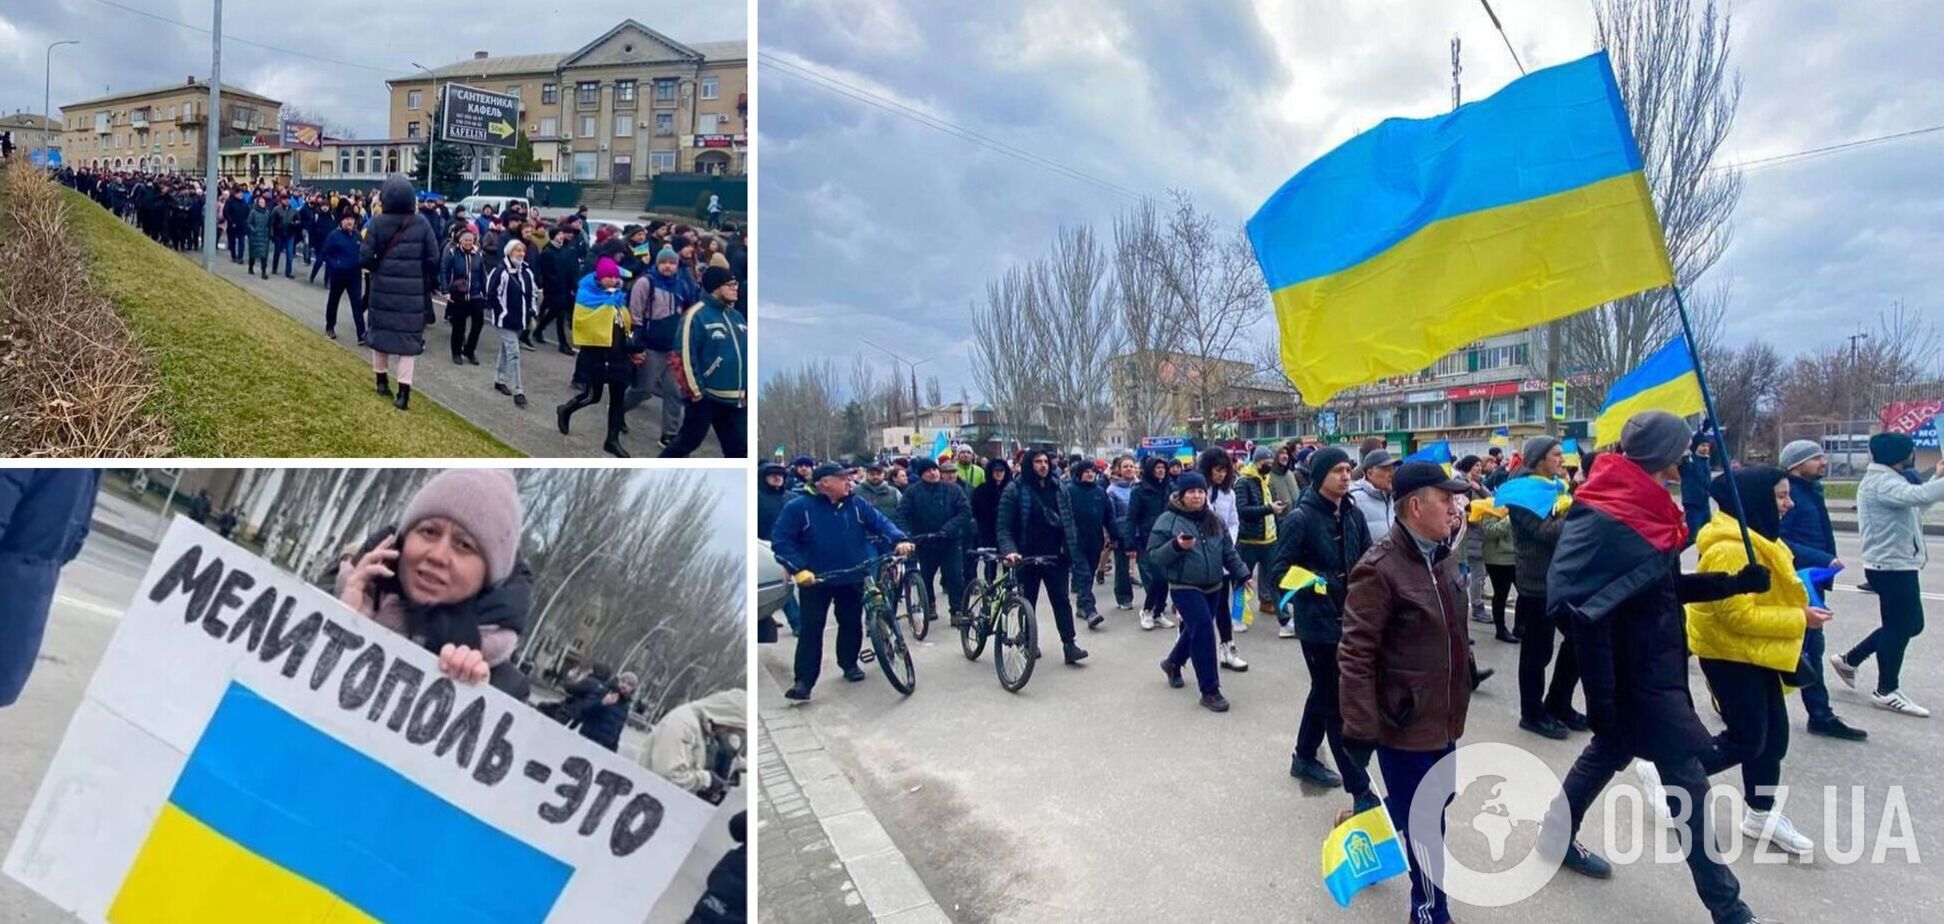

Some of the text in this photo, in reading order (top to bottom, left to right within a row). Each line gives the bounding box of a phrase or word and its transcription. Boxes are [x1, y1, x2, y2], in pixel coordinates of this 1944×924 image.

[457, 89, 513, 108] САНТЕХНИКА
[467, 103, 502, 117] КАФЕЛЬ
[149, 545, 514, 786] МЕЛИТОПОЛЬ
